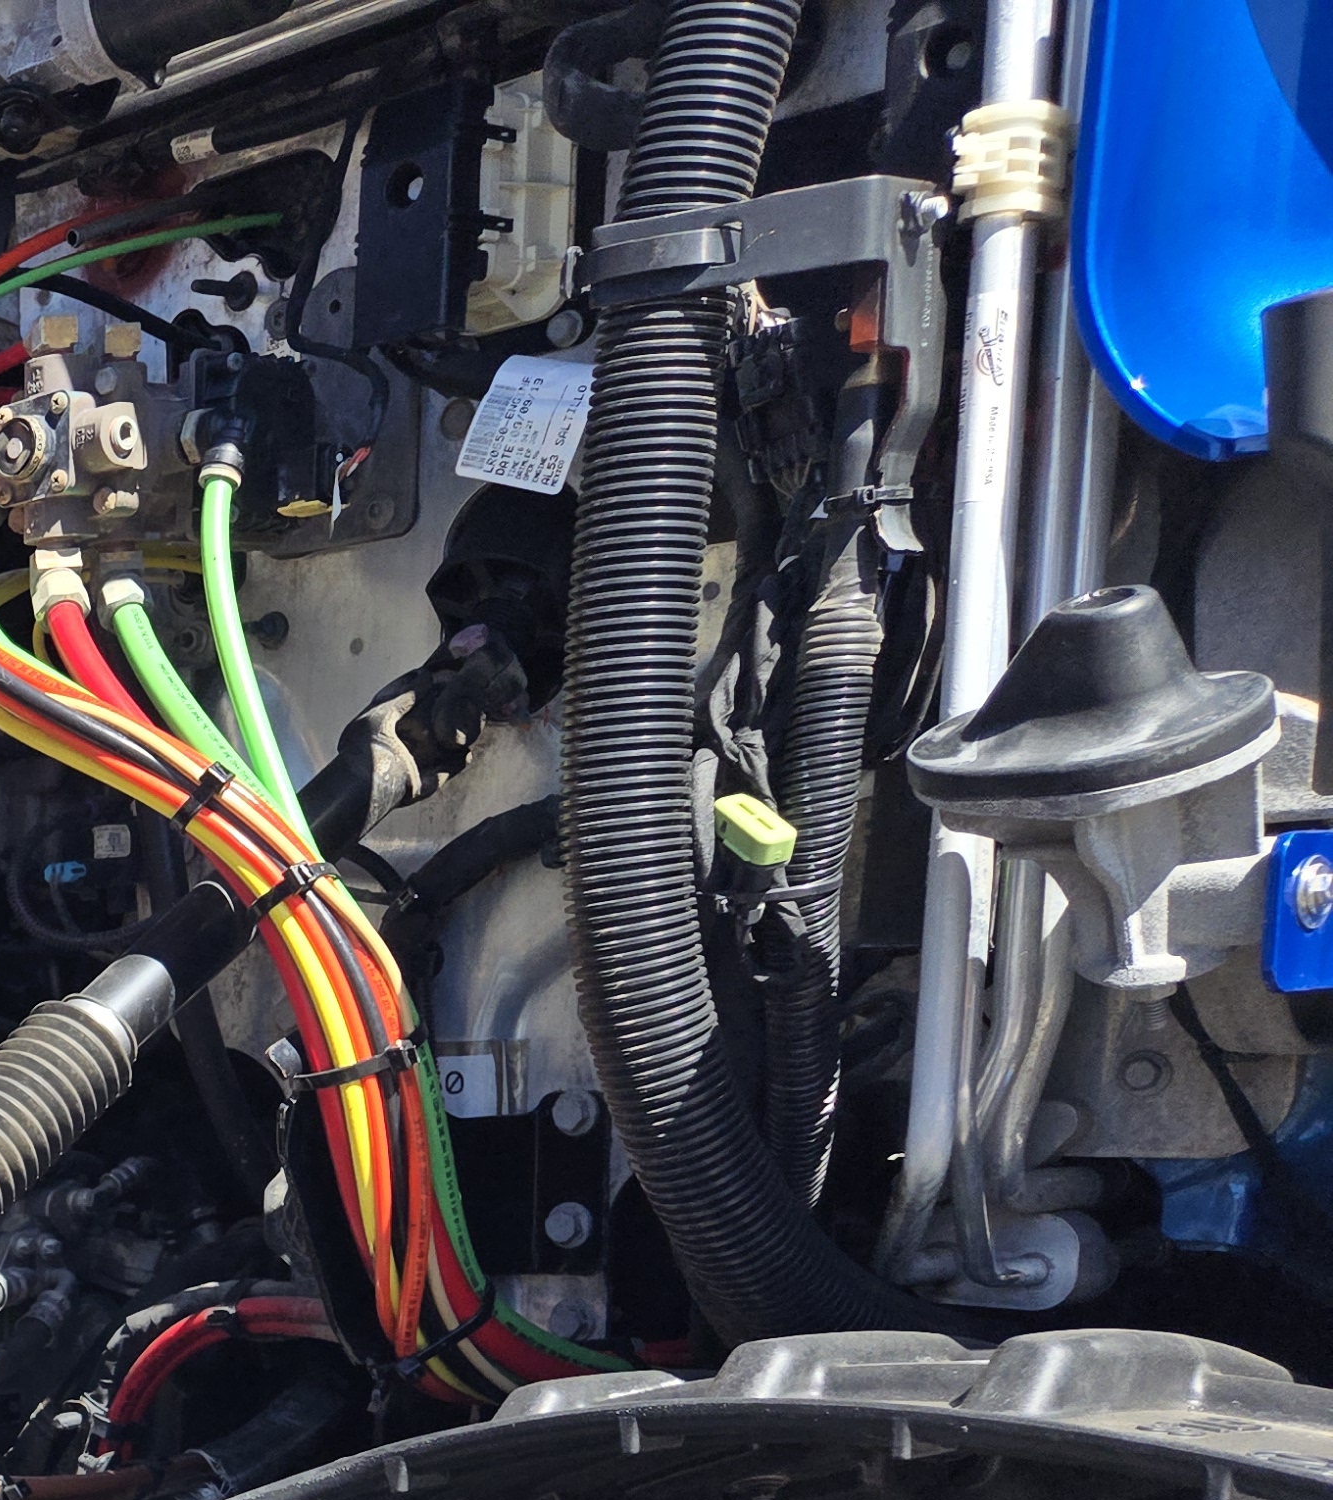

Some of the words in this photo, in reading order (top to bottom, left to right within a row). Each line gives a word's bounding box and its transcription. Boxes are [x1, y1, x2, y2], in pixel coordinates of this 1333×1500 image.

[541, 454, 559, 486] AL53
[555, 384, 587, 446] SALTILLO
[989, 406, 999, 434] Made
